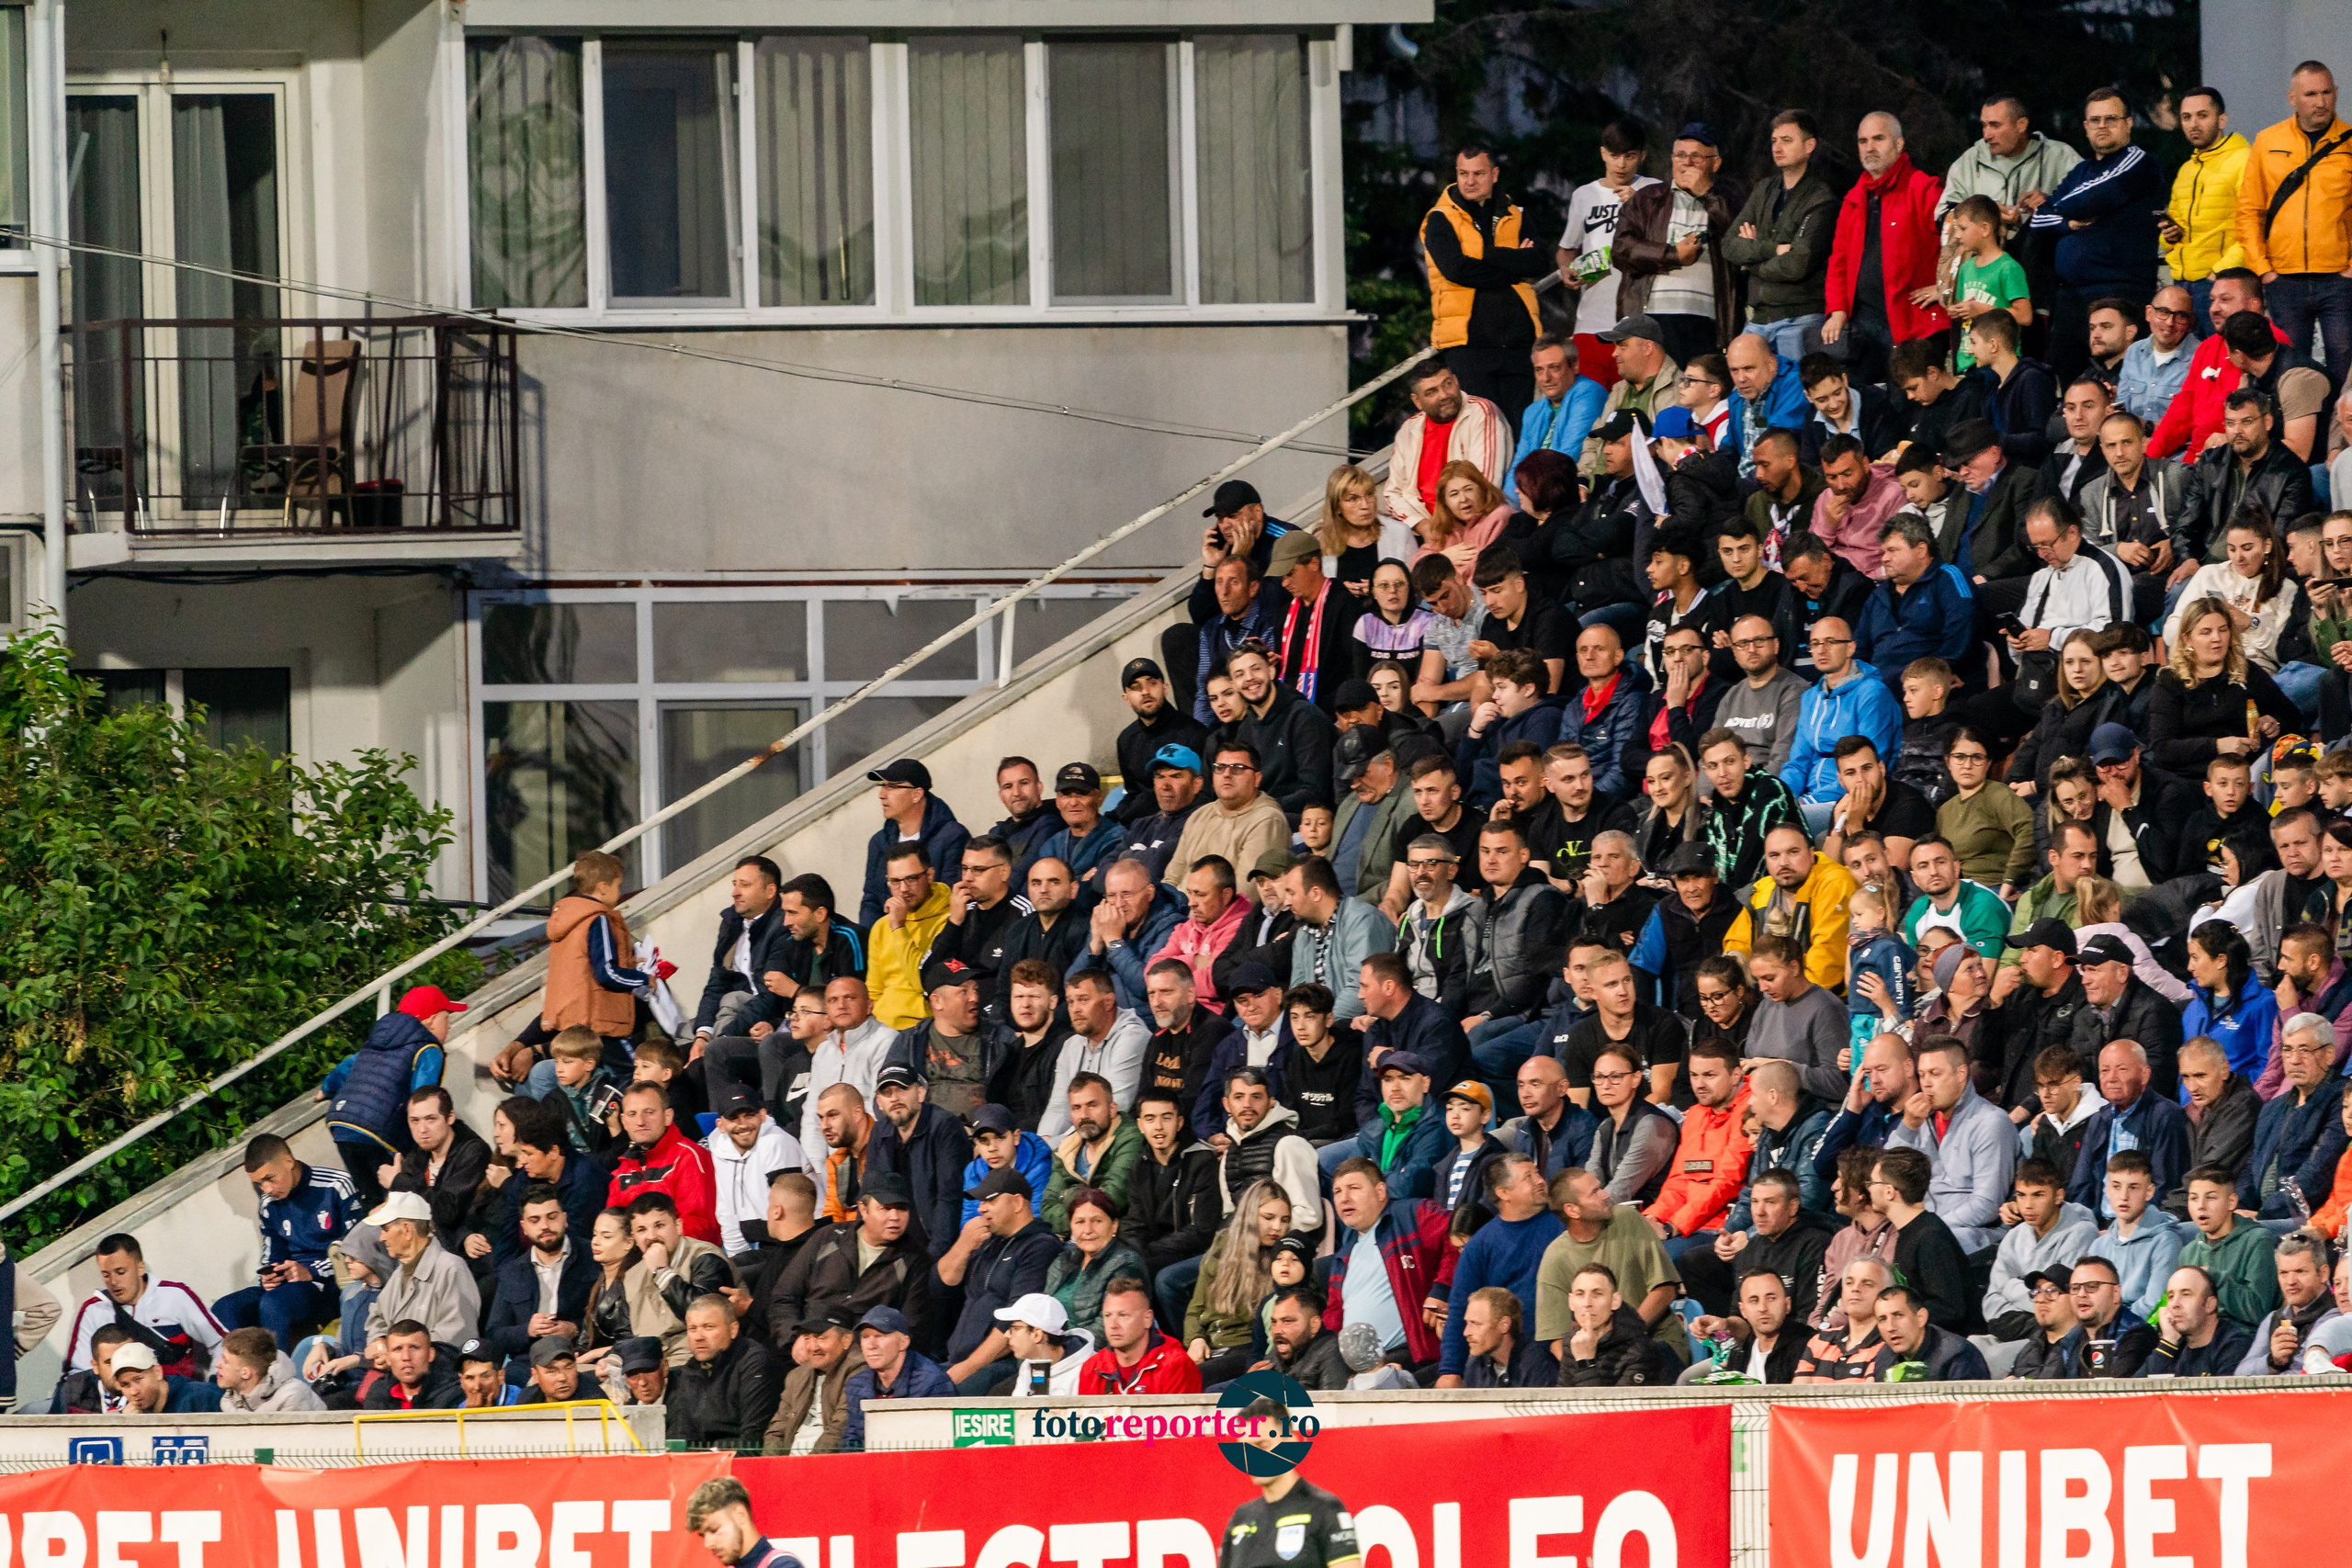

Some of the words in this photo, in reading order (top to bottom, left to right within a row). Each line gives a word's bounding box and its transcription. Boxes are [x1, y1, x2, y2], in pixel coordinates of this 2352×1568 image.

[1588, 204, 1619, 220] JUST
[282, 1219, 291, 1236] 9
[956, 1414, 1012, 1438] IESIRE
[1828, 1443, 2272, 1568] UNIBET
